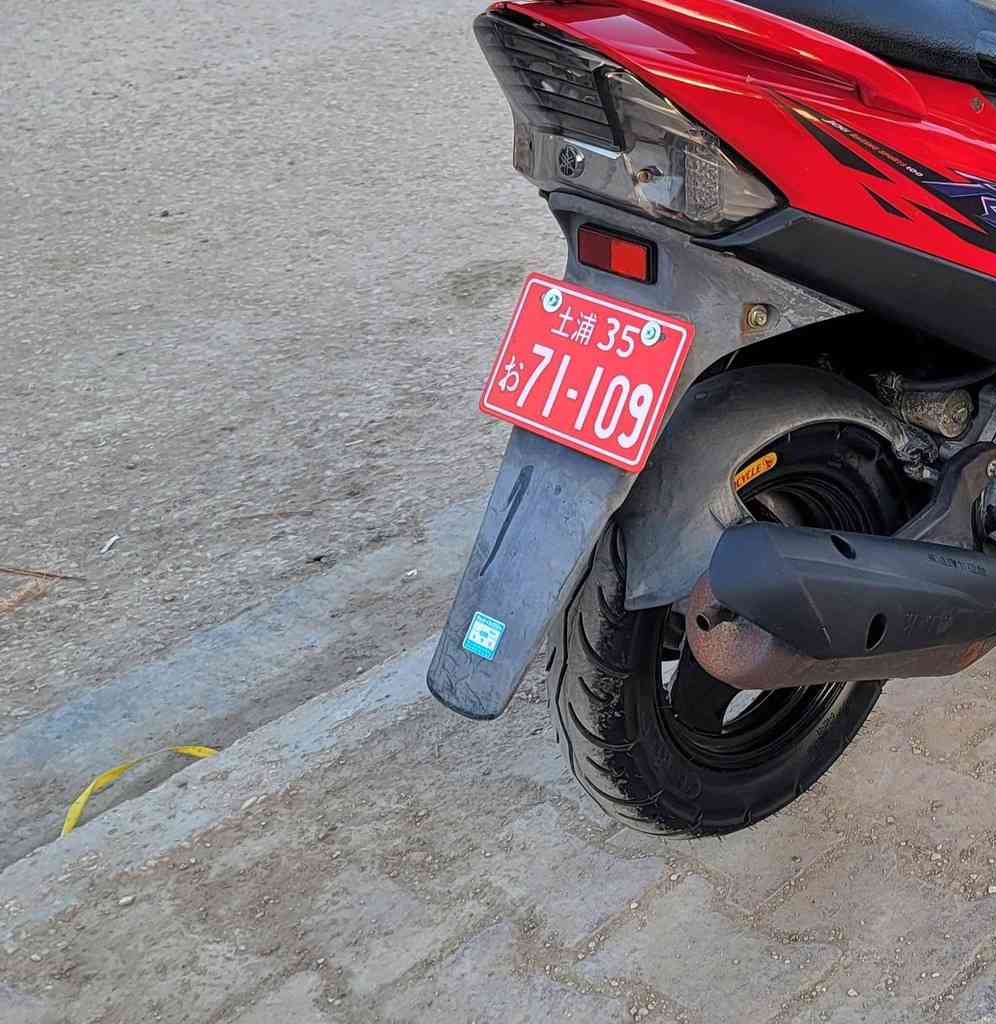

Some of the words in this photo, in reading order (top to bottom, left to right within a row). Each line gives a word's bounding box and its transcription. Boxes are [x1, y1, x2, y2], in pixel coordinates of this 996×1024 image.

[550, 306, 598, 346] 土浦
[597, 317, 641, 358] 35
[497, 353, 526, 392] お
[516, 344, 653, 449] 71-109
